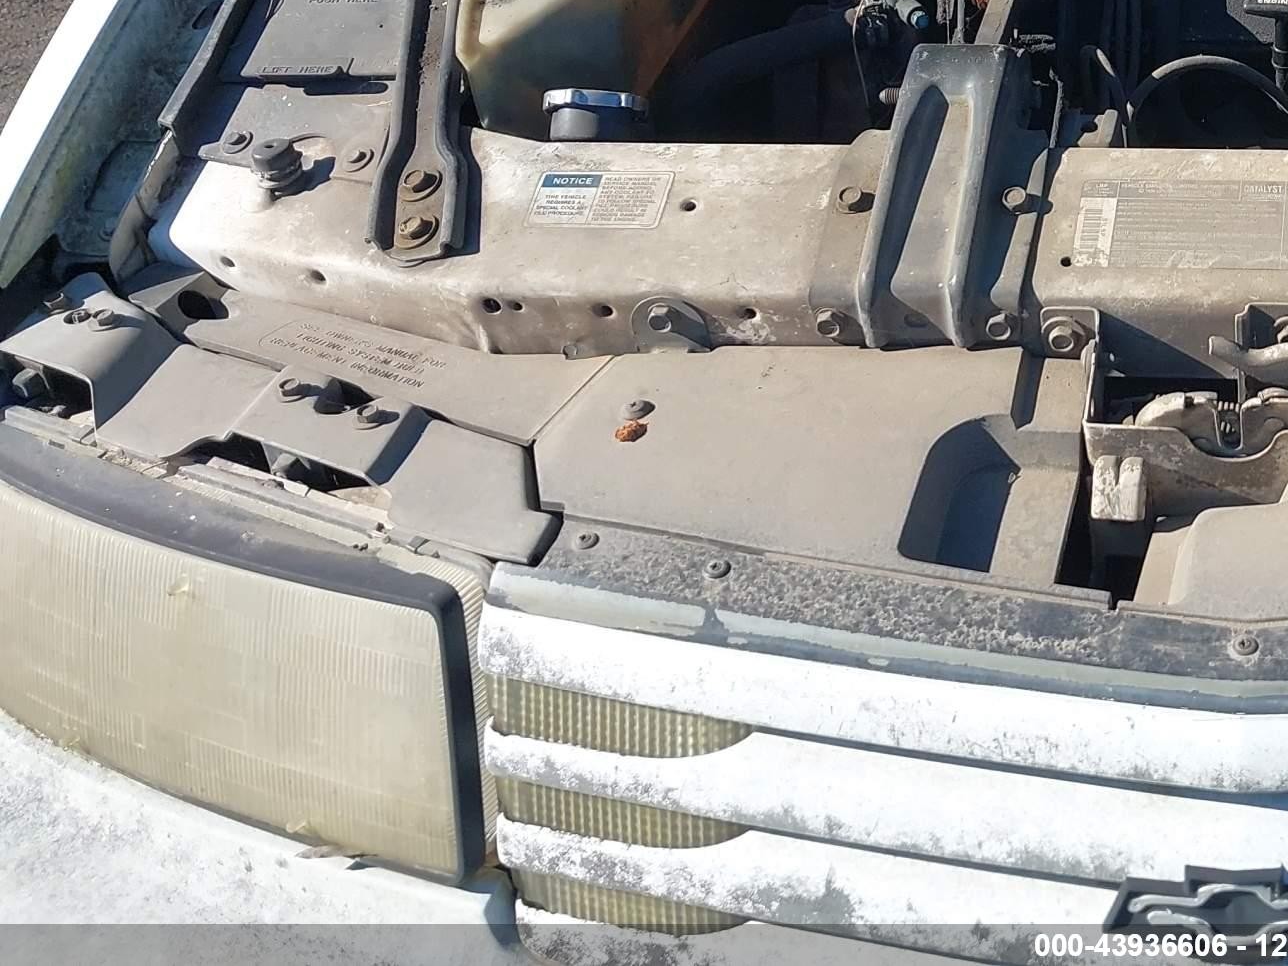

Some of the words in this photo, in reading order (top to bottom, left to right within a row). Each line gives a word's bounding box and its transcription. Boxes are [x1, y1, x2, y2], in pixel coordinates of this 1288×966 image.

[299, 66, 334, 74] HERE
[552, 177, 594, 185] NOTICE
[1243, 185, 1282, 193] CATALYST
